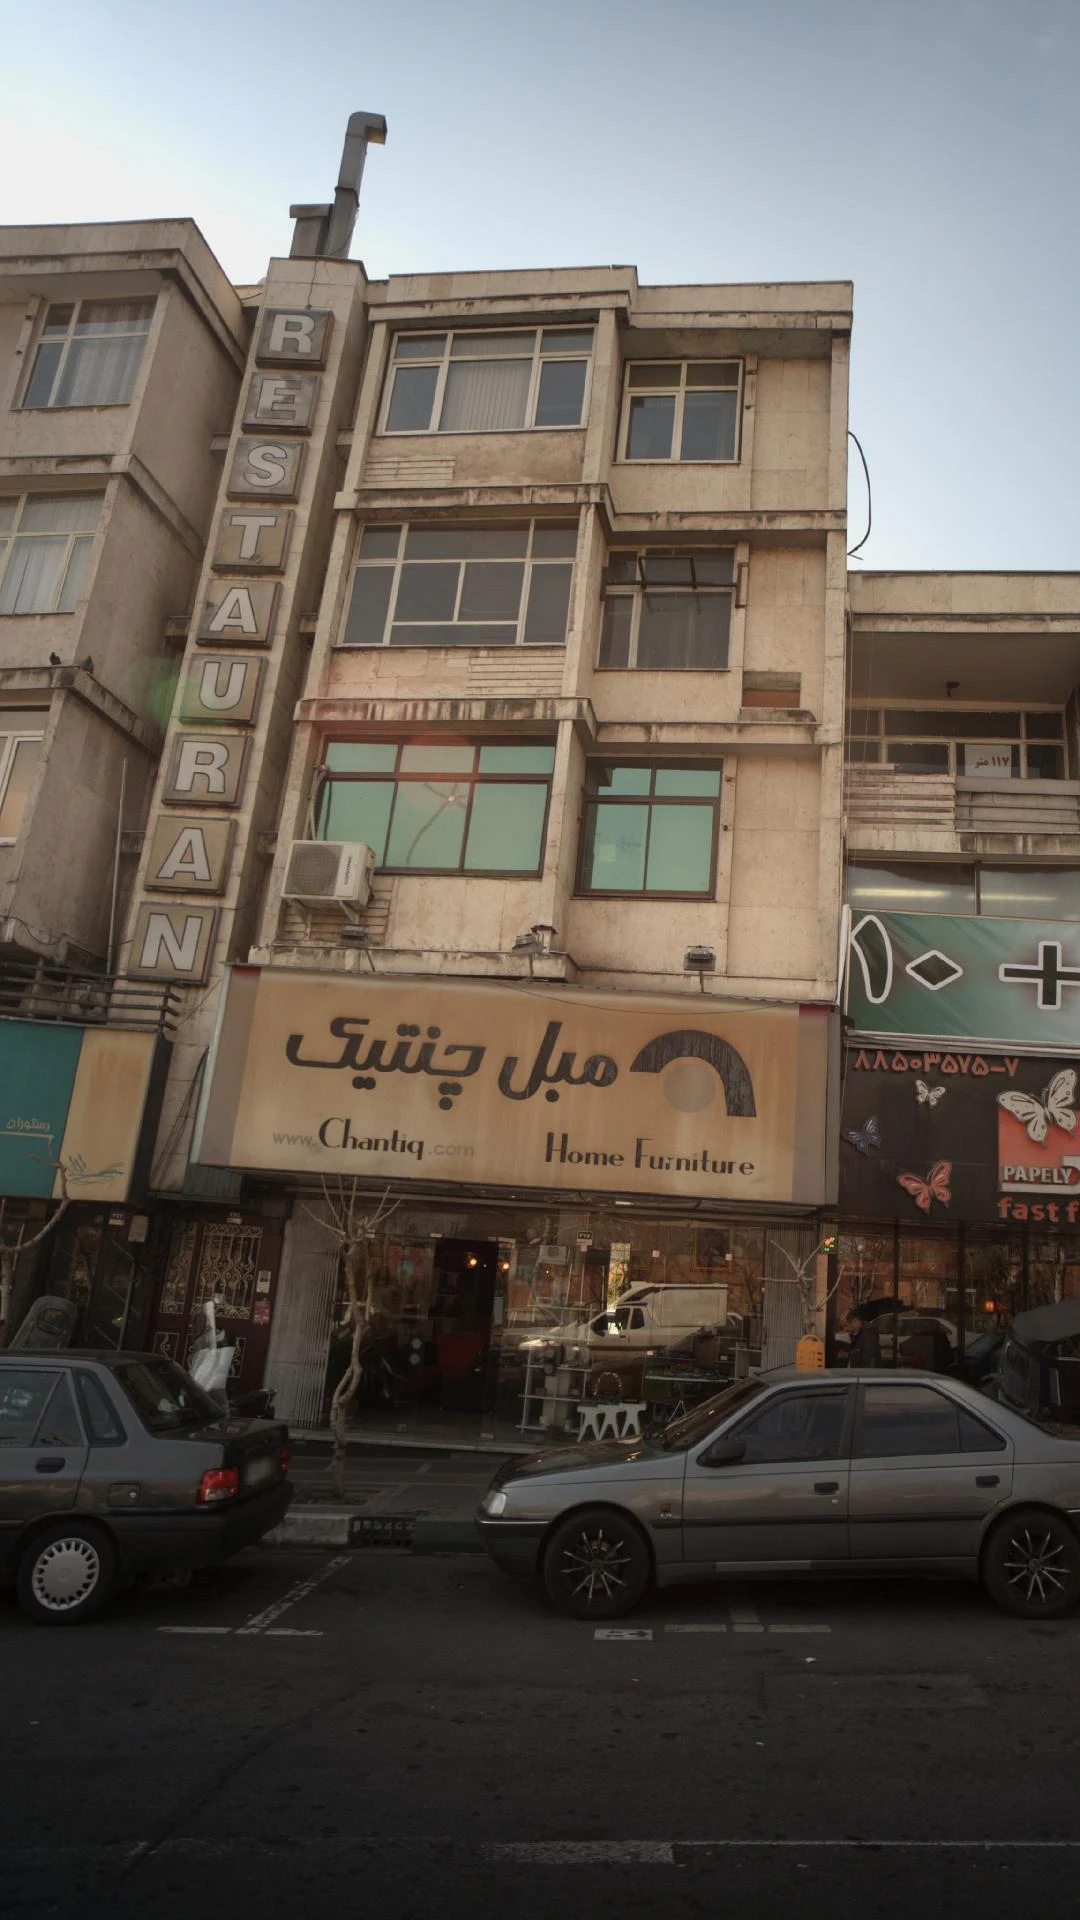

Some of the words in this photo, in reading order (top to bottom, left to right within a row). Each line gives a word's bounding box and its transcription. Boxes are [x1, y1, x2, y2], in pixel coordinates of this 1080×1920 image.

[139, 313, 316, 972] RESTAURAN
[498, 1020, 619, 1101] مبل
[545, 1131, 625, 1167] Home
[634, 1137, 755, 1175] Furniture
[1003, 1164, 1073, 1184] PAPELY
[997, 1195, 1060, 1223] fast
